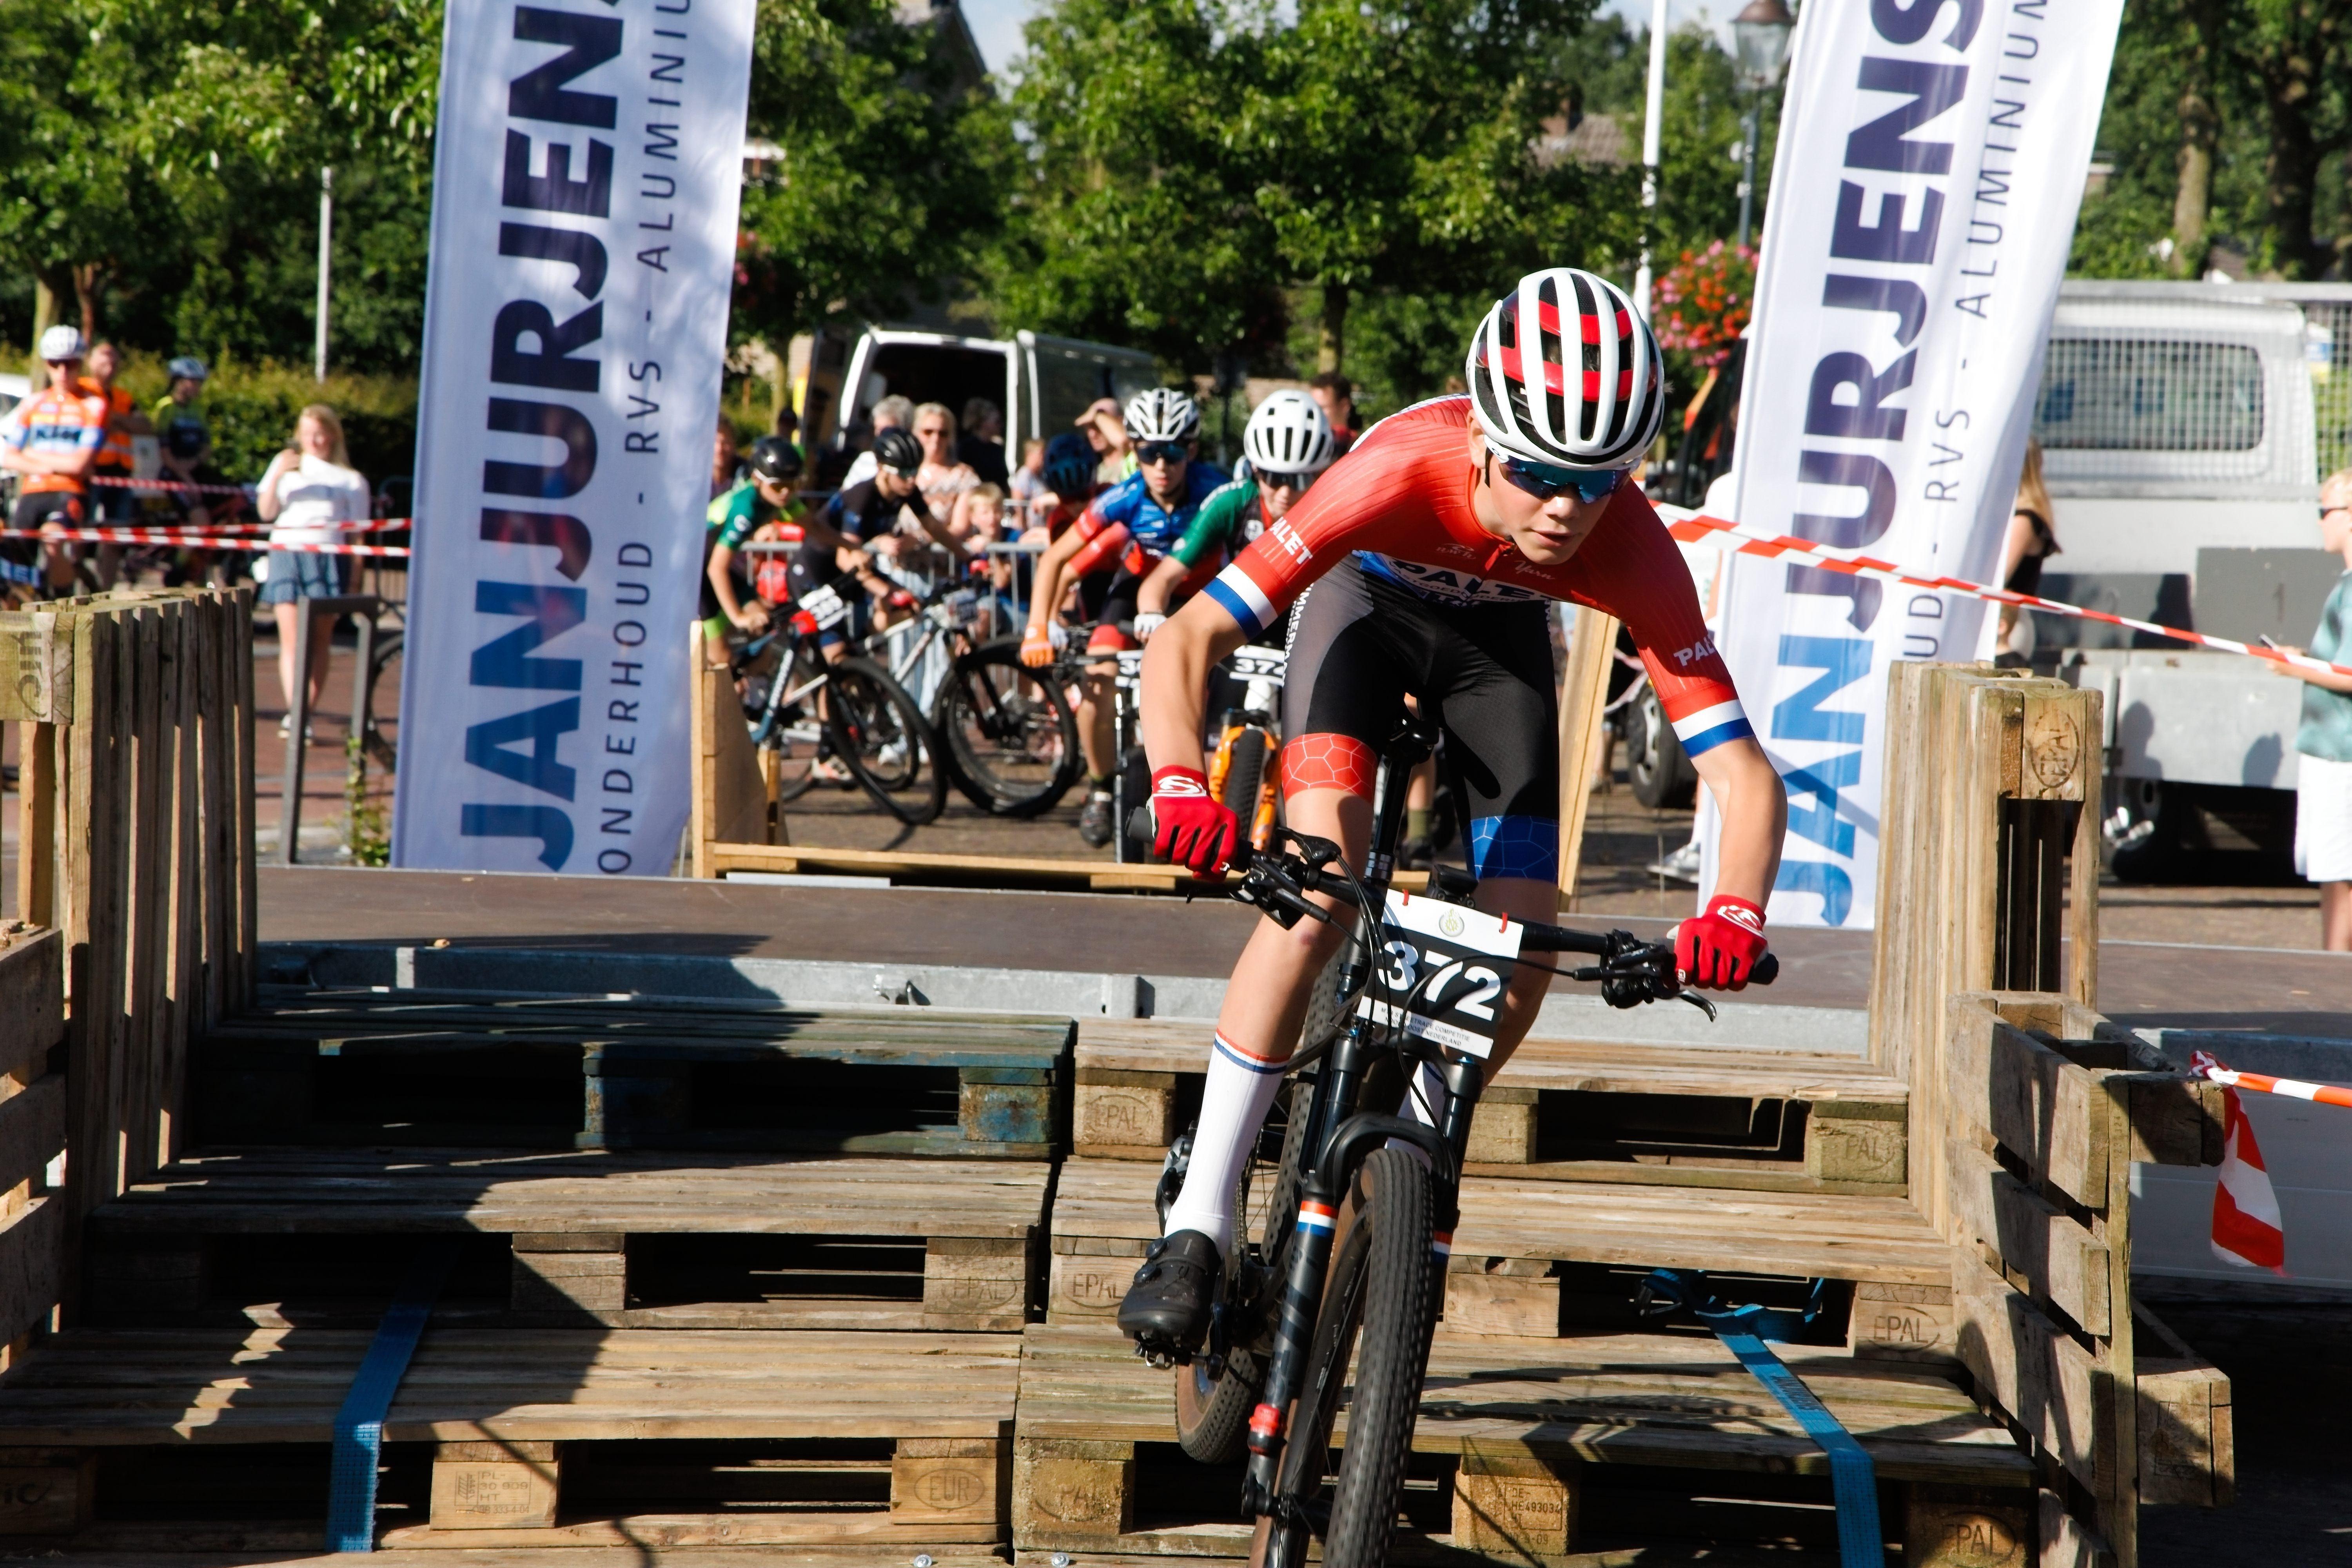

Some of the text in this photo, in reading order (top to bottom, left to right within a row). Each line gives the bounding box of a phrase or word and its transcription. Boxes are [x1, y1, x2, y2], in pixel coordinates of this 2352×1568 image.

[460, 0, 624, 871] JANJURJEN
[1925, 409, 1970, 502] RVS
[1514, 560, 1555, 580] Yarn
[597, 543, 652, 874] ONDERHOUD
[625, 361, 661, 453] RVS
[1377, 941, 1501, 1021] 372
[1426, 1030, 1462, 1046] NEDERLAND
[1435, 1025, 1470, 1041] COMPETITIE
[1073, 1273, 1124, 1299] EPAL
[1873, 1316, 1929, 1344] EPAL
